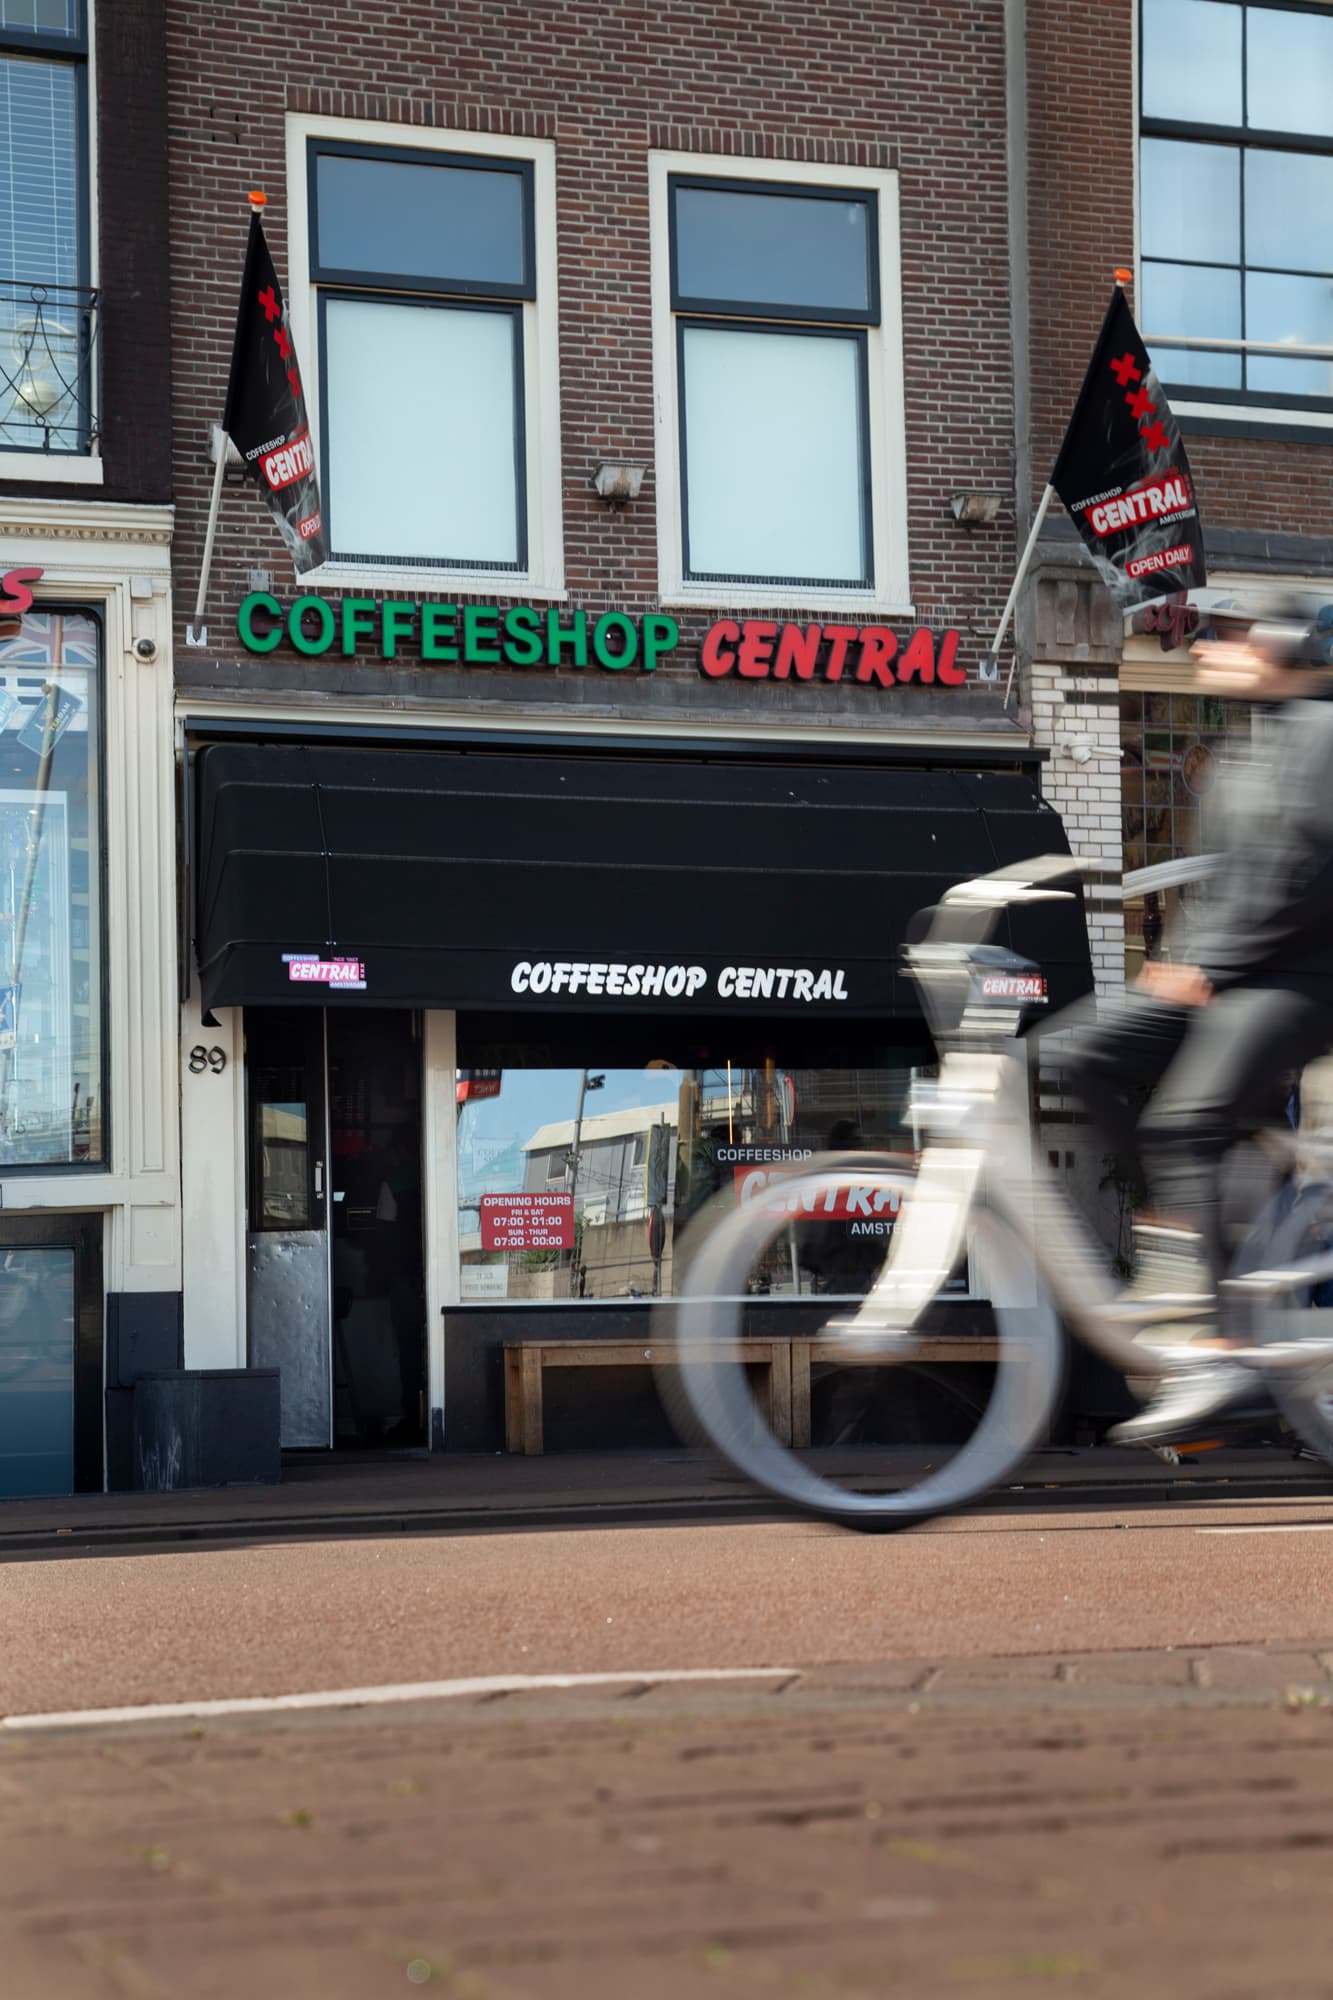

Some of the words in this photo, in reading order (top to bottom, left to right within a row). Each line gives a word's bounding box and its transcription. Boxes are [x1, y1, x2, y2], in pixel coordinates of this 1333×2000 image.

[245, 435, 286, 461] COFFEESHOP
[1071, 486, 1122, 512] COFFEESHOP
[1092, 479, 1187, 533] CENTRAL
[1130, 557, 1164, 576] OPEN
[1165, 547, 1191, 565] DAILY
[237, 591, 680, 672] COFFEESHOP
[701, 619, 968, 688] CENTRAL
[291, 963, 358, 980] CENTRAL
[511, 961, 707, 998] COFFEESHOP
[717, 967, 848, 1002] CENTRAL
[983, 978, 1042, 995] CENTRAL
[188, 1045, 227, 1075] 89
[717, 1148, 812, 1161] COFFEESHOP
[483, 1197, 532, 1207] OPENING
[534, 1196, 571, 1206] HOURS
[530, 1208, 545, 1216] SAT
[493, 1217, 524, 1226] 07:00
[531, 1216, 563, 1226] 01:00
[529, 1228, 549, 1236] THUR
[493, 1237, 525, 1246] 07:00
[532, 1236, 563, 1246] 00:00
